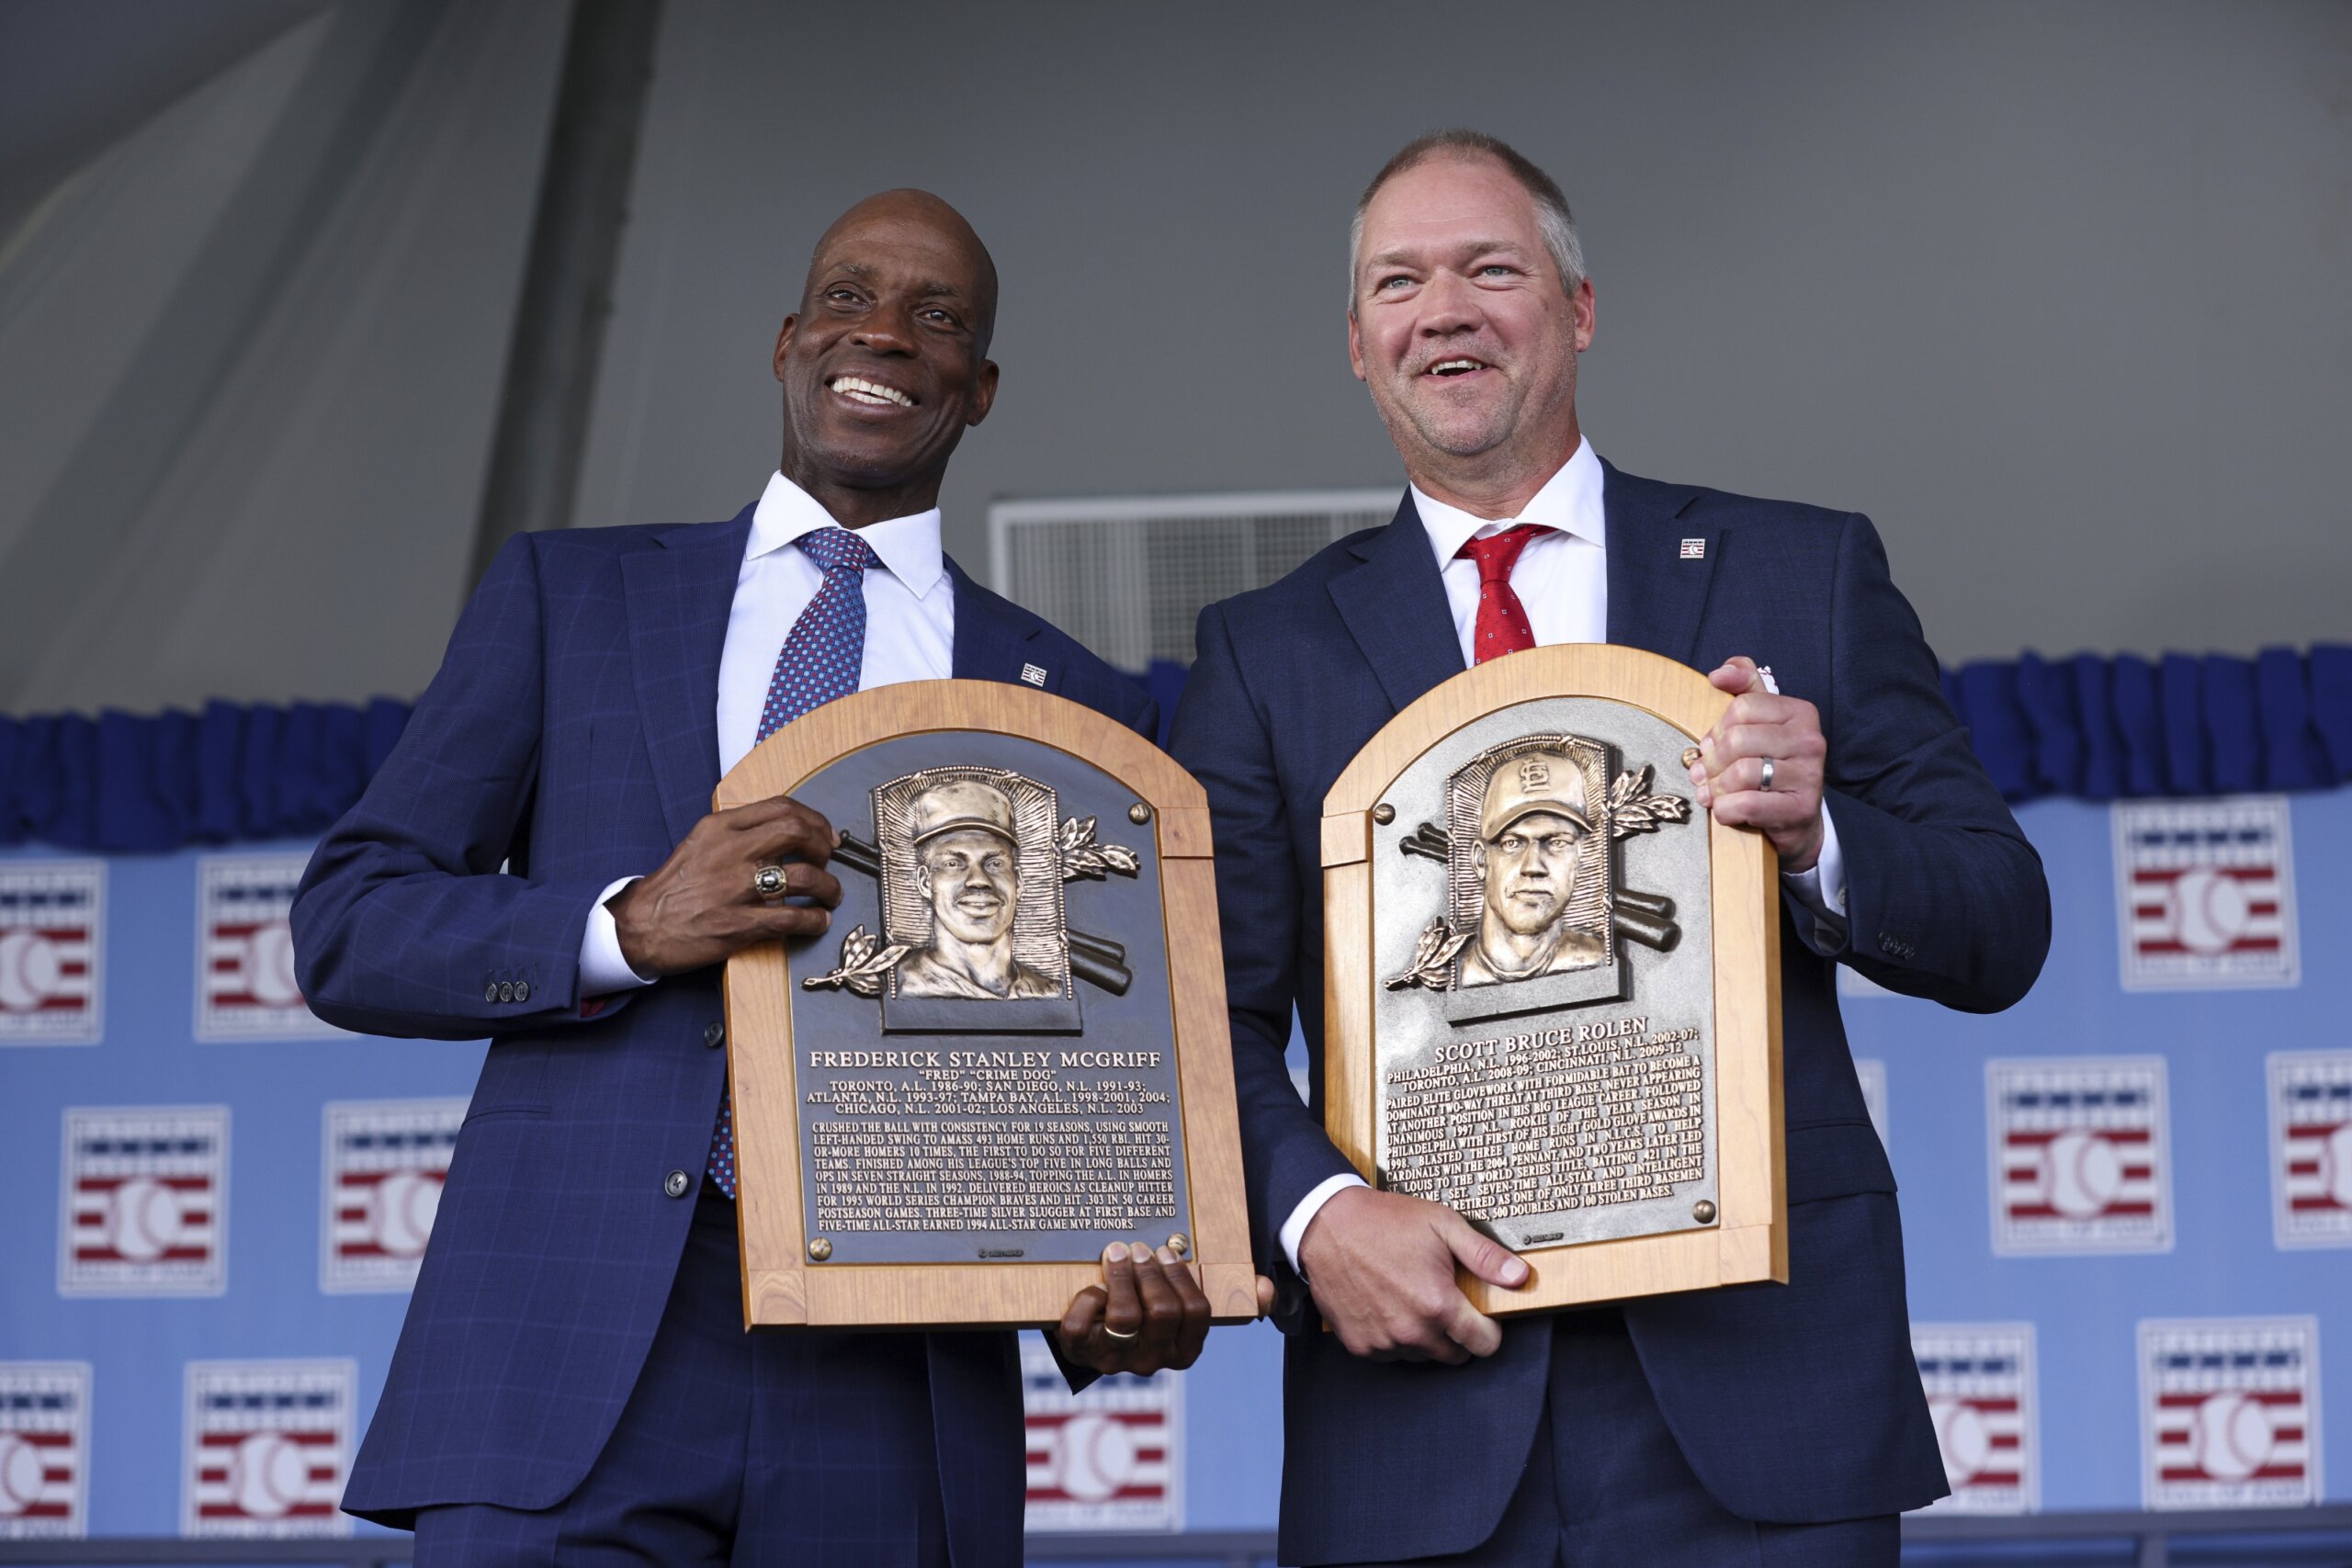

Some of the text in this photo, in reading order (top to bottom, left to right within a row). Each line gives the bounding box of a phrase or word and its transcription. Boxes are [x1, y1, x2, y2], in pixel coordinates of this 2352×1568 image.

[1434, 1017, 1646, 1064] SCOTT BRUCE ROLEN
[810, 1052, 1160, 1066] FREDERICK STANLEY MCGRIFF
[1386, 1062, 1474, 1084] PHILADELPHIA,
[1477, 1058, 1499, 1070] N.L.
[1504, 1049, 1561, 1066] 1996-2002;
[1624, 1036, 1647, 1049] N.L.
[1652, 1029, 1699, 1044] 2002-07;
[1402, 1043, 1682, 1092] TORONTO, A.L. 2008-09; CINCINNATI, N.L. 2009-12
[829, 1081, 1146, 1093] TORONTO, A.L. 1986-90; SAN DIEGO, N.L. 1991-93;
[1385, 1055, 1701, 1110] PAIRED ELITE GLOVEWORK WITH FORMIDABLE BAT TO BECOME A
[807, 1092, 1170, 1104] ATLANTA, N.L. 1993-97; TAMPA BAY, A.L. 1998-2001, 2004;
[1386, 1067, 1701, 1122] DOMINANT TWO-WAY THREAT AT THIRD BASE, NEVER APPEARING
[835, 1104, 1143, 1116] CHICAGO, N.L. 2001-02; LOS ANGELES, N.L. 2003
[1386, 1079, 1701, 1134] AT ANOTHER POSITION IN HIS BIG LEAGUE CAREER. FOLLOWED
[1386, 1092, 1701, 1146] UNANIMOUS 1997 N.L. ROOKIE OF THE YEAR SEASON IN
[812, 1122, 1168, 1134] CRUSHED THE BALL WITH CONSISTENCY FOR 19 SEASONS, USING SMOOTH
[813, 1134, 1169, 1145] LEFT-HANDED SWING TO AMASS 493 HOME RUNS AND 1,550 RBI. HIT 30-
[1419, 1151, 1463, 1167] BLASTED
[1469, 1145, 1503, 1159] THREE
[1511, 1140, 1540, 1154] HOME
[1549, 1135, 1576, 1148] RUNS
[1584, 1133, 1596, 1144] IN
[1653, 1122, 1666, 1134] TO
[1673, 1117, 1702, 1131] HELP
[814, 1145, 1170, 1158] OR-MORE HOMERS 10 TIMES, THE FIRST TO DO SO FOR FIVE DIFFERENT
[814, 1159, 851, 1168] TEAMS.
[855, 1158, 903, 1168] FINISHED
[907, 1158, 943, 1168] AMONG
[947, 1158, 964, 1168] HIS
[1019, 1157, 1039, 1168] TOP
[1044, 1157, 1066, 1168] FIVE
[1070, 1157, 1080, 1168] IN
[1085, 1157, 1113, 1168] LONG
[1116, 1157, 1147, 1168] BALLS
[1151, 1157, 1170, 1168] AND
[818, 1206, 1175, 1218] POSTSEASON GAMES. THREE-TIME SILVER SLUGGER AT FIRST BASE AND
[819, 1218, 1136, 1231] FIVE-TIME ALL-STAR EARNED 1994 ALL-STAR GAME MVP HONORS.
